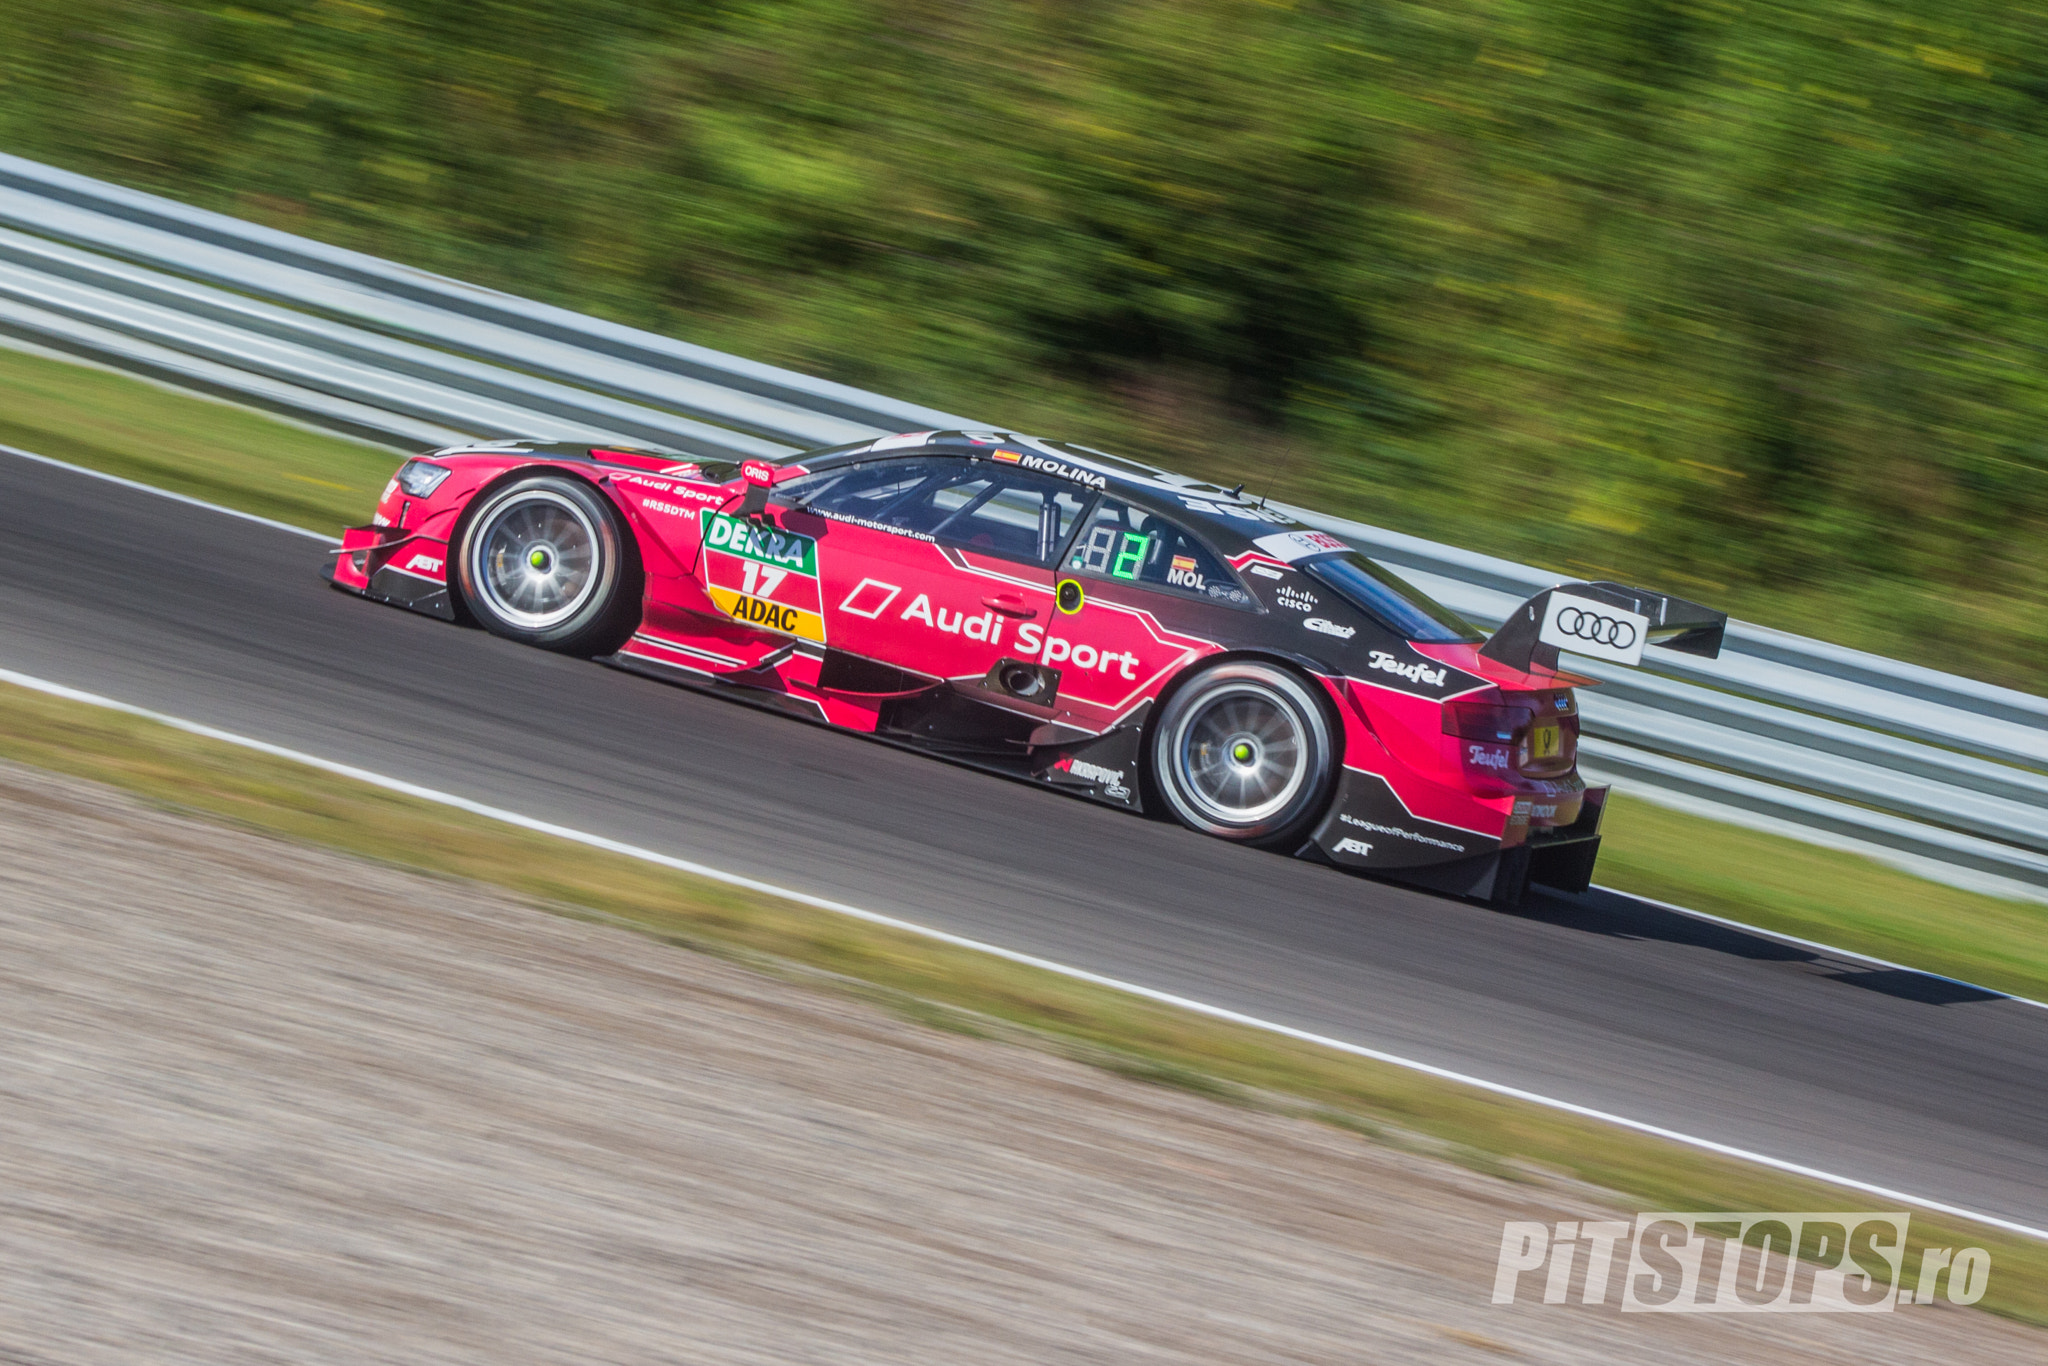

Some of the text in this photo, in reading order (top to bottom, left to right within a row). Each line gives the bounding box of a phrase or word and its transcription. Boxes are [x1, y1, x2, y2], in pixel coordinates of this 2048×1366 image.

[745, 465, 769, 482] ORIS
[1022, 455, 1105, 489] MOLINA
[629, 476, 724, 505] Audi Sport
[807, 506, 935, 543] www.audi-motorsport.com
[709, 517, 803, 568] DEKRA
[405, 554, 443, 573] ABT
[742, 560, 788, 598] 17
[1167, 569, 1206, 590] MOL
[732, 595, 798, 631] ADAC
[1277, 596, 1312, 612] cisco
[900, 594, 1139, 680] Audi Sport
[1368, 651, 1447, 687] Teufel
[1469, 745, 1509, 770] Teufel
[1332, 837, 1373, 857] ABT
